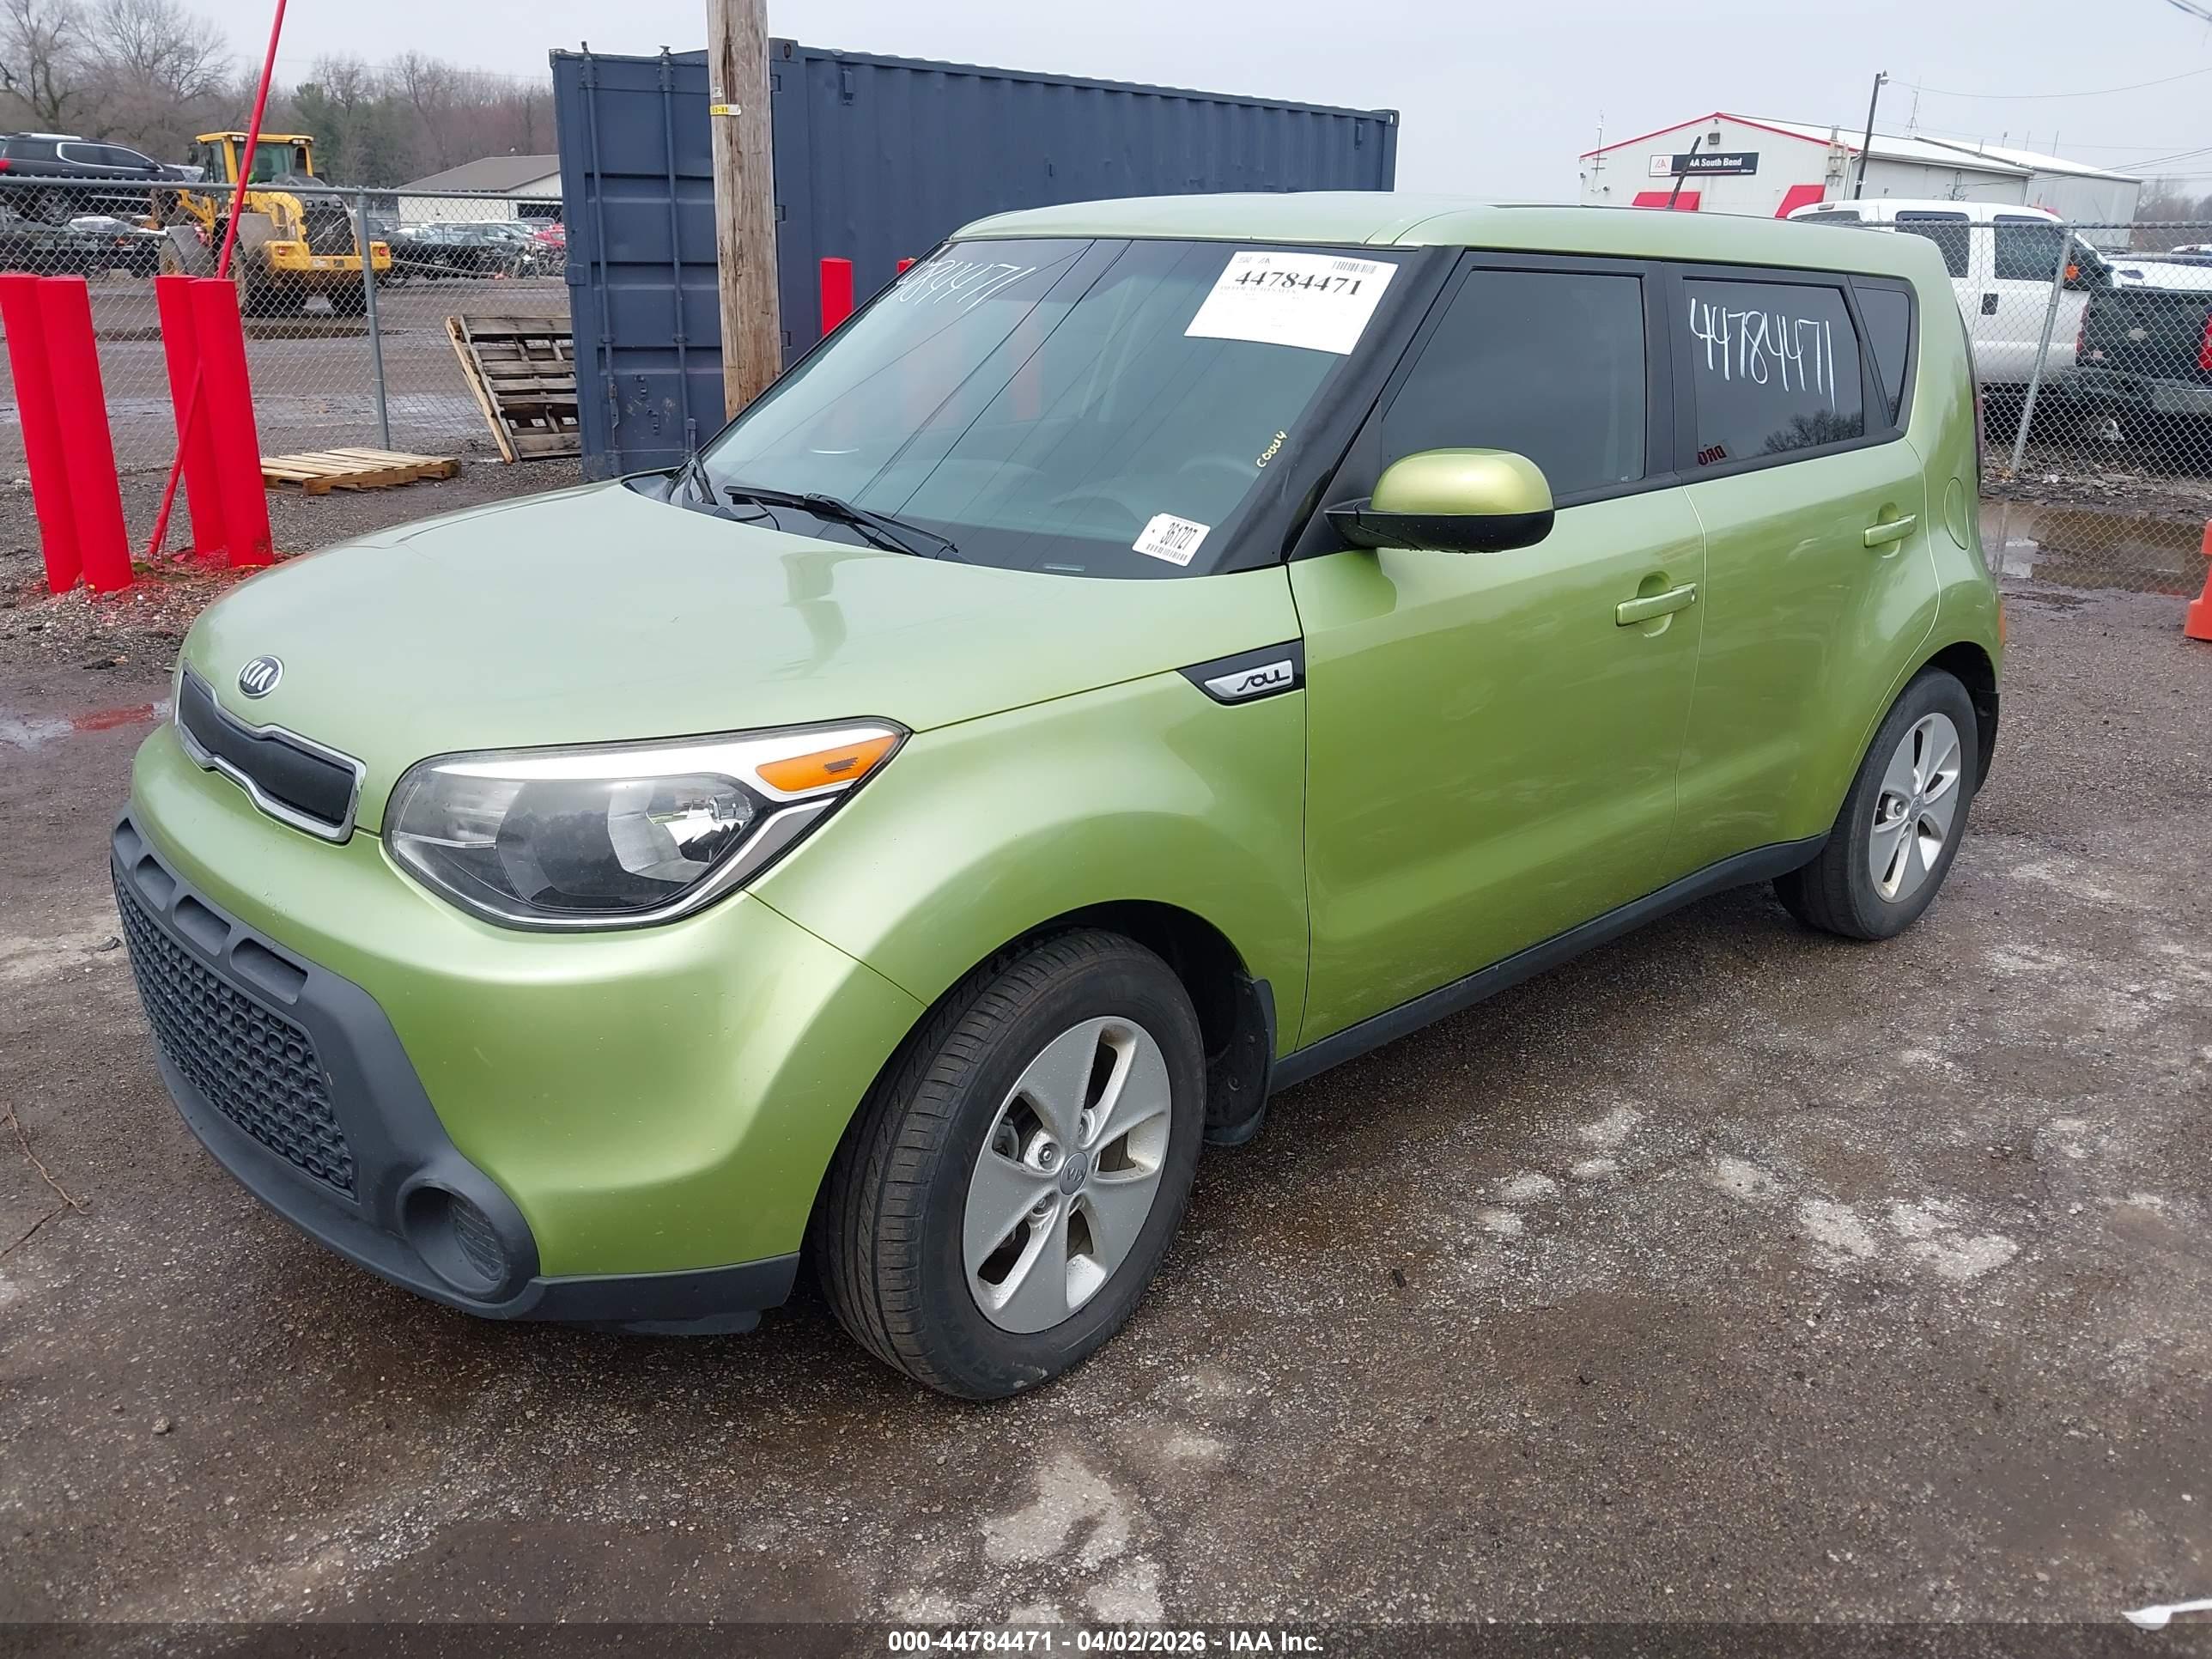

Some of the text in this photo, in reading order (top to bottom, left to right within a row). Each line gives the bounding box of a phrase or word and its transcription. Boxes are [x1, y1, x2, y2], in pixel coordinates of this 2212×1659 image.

[1701, 158, 1722, 167] South
[1723, 157, 1742, 166] Bend
[1234, 270, 1363, 296] 44784471
[1689, 297, 1836, 412] 44784471
[240, 659, 275, 692] KIA
